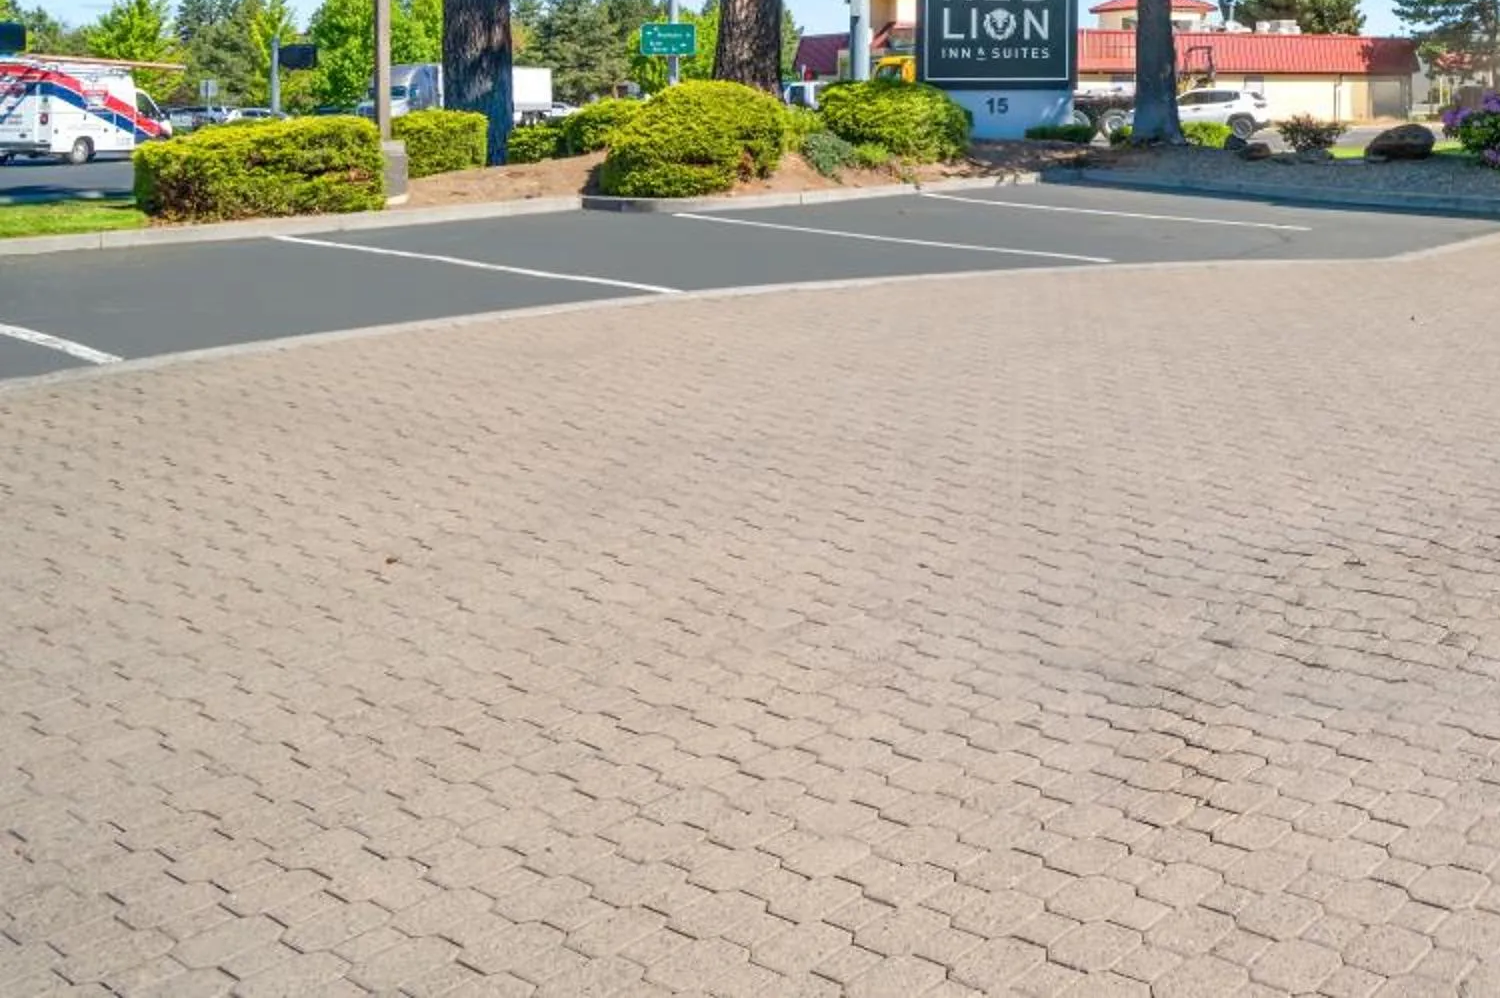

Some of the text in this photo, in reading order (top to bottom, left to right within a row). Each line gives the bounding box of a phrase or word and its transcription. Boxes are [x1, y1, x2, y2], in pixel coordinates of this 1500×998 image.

[941, 47, 972, 59] INN
[991, 47, 1050, 60] SUITES
[986, 97, 1009, 114] 15
